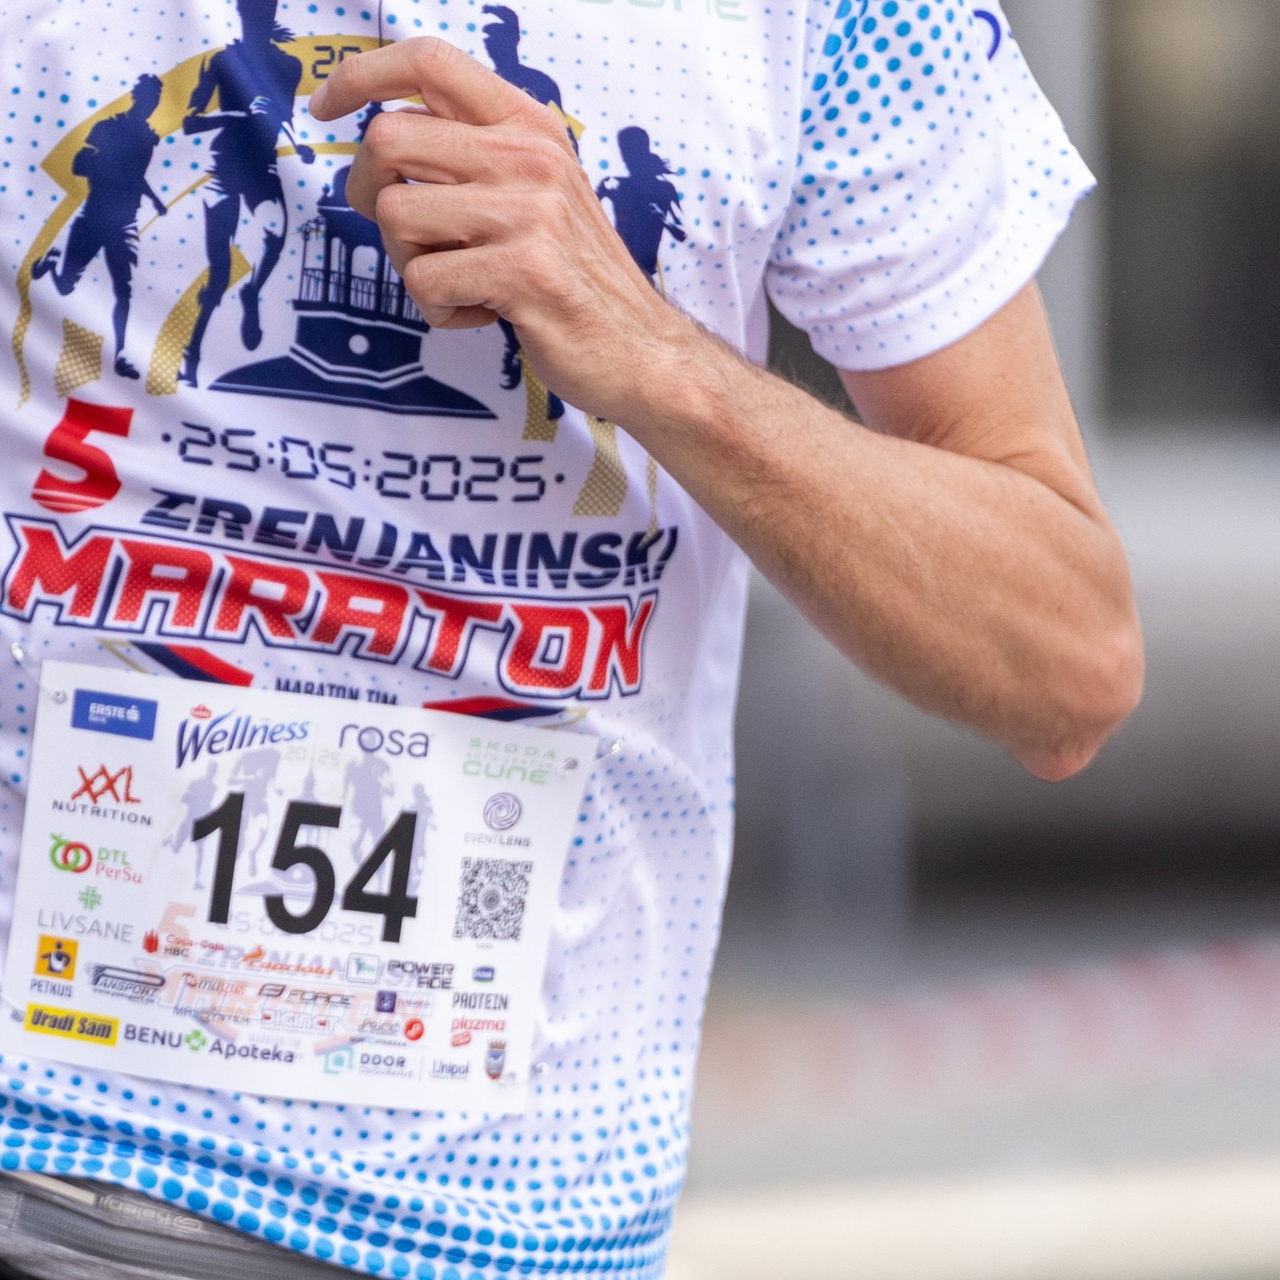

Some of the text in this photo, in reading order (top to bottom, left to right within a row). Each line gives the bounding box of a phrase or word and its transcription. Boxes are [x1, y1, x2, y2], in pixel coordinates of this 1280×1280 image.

[31, 398, 134, 513] 5
[141, 488, 679, 588] ZRENJANINSKI
[0, 515, 657, 698] MARATON
[88, 702, 126, 720] ERSTE
[176, 708, 311, 769] Wellness
[339, 723, 429, 757] rosa
[71, 764, 142, 805] XXL
[52, 799, 153, 827] NUTRITION
[97, 847, 131, 866] DTL
[191, 791, 419, 944] 154
[37, 908, 135, 943] LIVSANE
[164, 946, 190, 958] HBC
[387, 960, 454, 976] POWER
[30, 978, 74, 998] PETKUS
[286, 988, 355, 1006] FORCE
[452, 991, 511, 1010] PROTEIN
[31, 1008, 113, 1039] Uradi Sam
[451, 1017, 506, 1033] plazma
[124, 1023, 184, 1049] BENU
[209, 1038, 296, 1064] Apoteka
[359, 1053, 407, 1068] DDOR
[432, 1058, 470, 1079] Unipol
